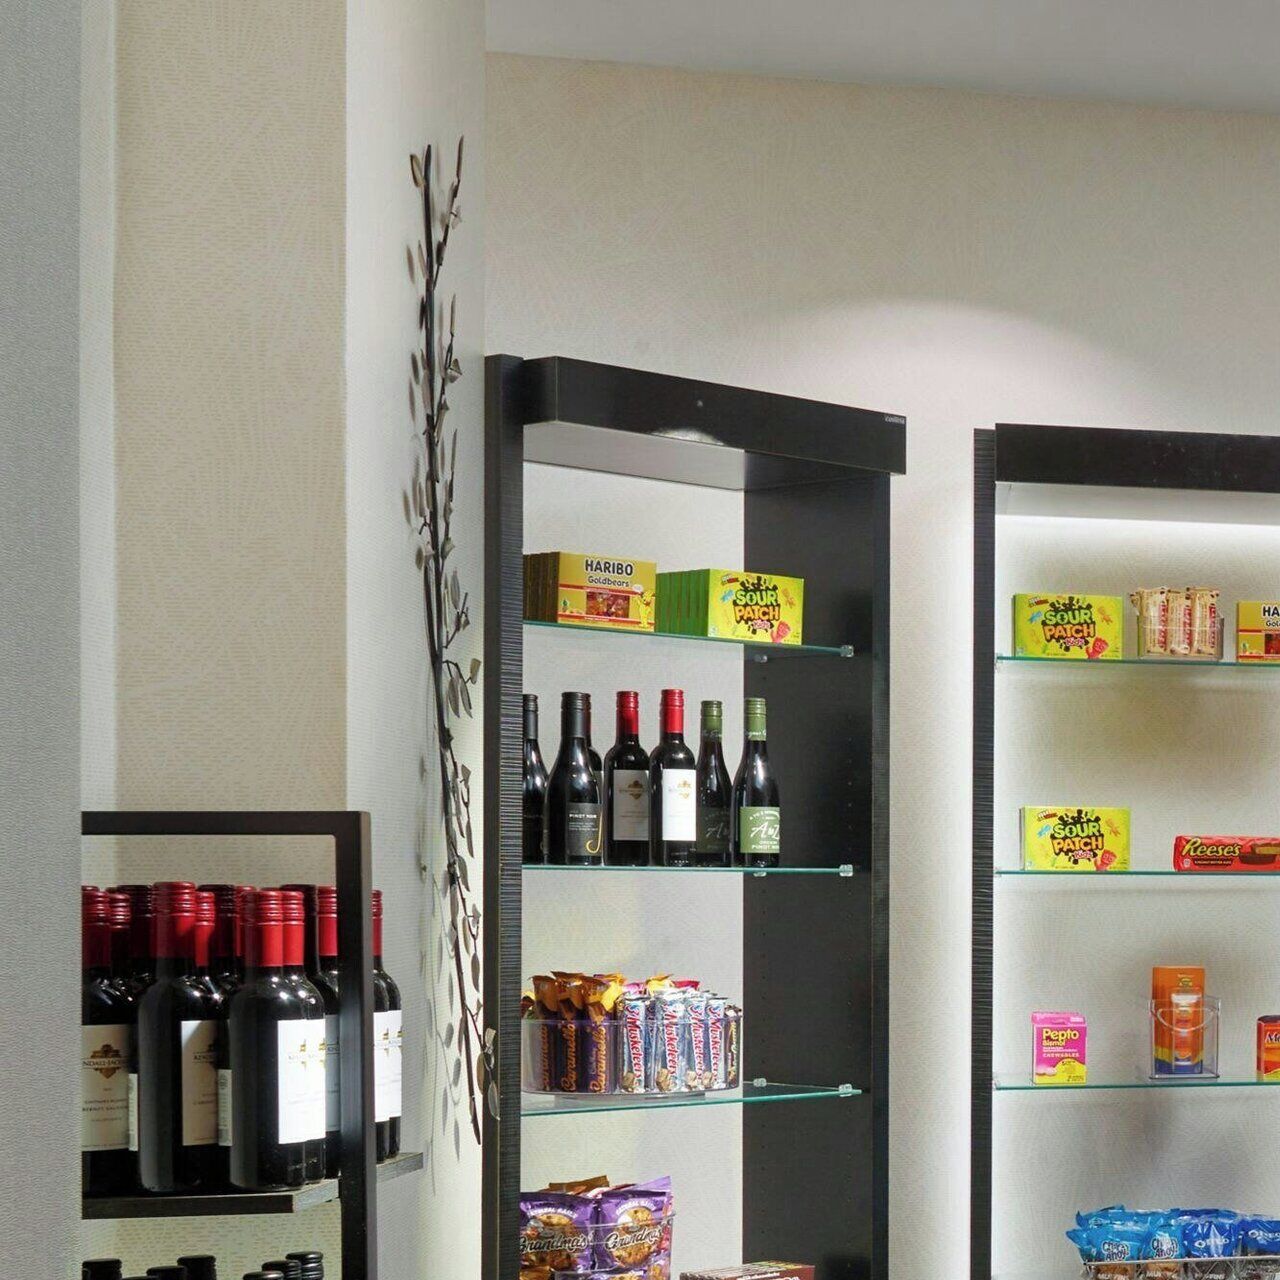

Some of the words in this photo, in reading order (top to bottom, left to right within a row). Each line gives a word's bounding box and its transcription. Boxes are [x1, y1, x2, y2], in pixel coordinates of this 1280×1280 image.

[585, 559, 634, 576] HARIBO
[587, 576, 629, 587] Goldbears
[735, 589, 778, 605] SOUR
[734, 604, 780, 621] PATCH
[1044, 609, 1093, 625] SOUR
[1043, 623, 1096, 641] PATCH
[1053, 822, 1100, 838] SOUR
[1051, 836, 1103, 853] PATCH
[1042, 1028, 1080, 1042] Pepto
[626, 1015, 644, 1078] Musketeers
[691, 1015, 704, 1078] Musketeers
[709, 1017, 722, 1078] Musketeers
[604, 1226, 664, 1251] Grandma's
